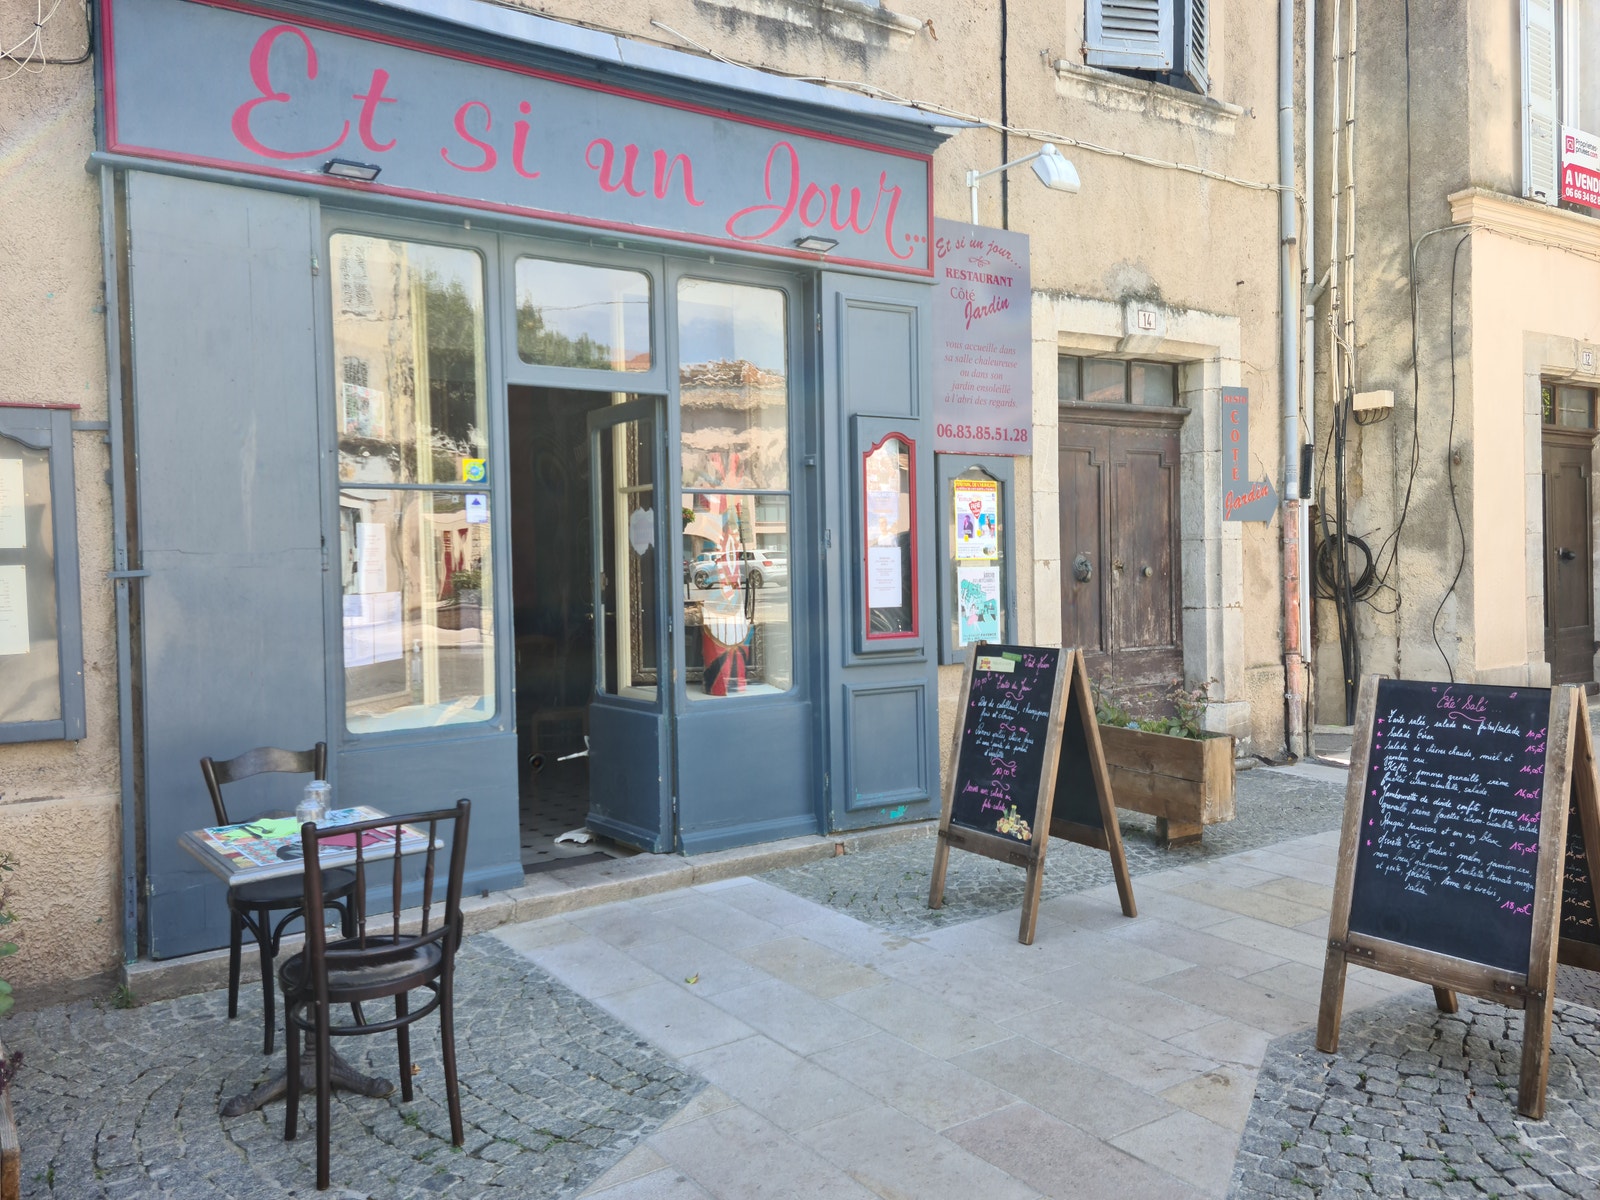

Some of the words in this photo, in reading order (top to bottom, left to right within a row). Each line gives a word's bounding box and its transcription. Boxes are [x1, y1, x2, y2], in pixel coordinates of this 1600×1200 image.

[231, 24, 398, 160] Et
[440, 100, 541, 180] si
[585, 138, 706, 207] un
[1565, 169, 1573, 186] A
[1574, 171, 1600, 195] VEND
[1565, 187, 1573, 197] 06
[1582, 191, 1590, 202] 34
[935, 237, 951, 258] Et
[955, 236, 966, 250] si
[969, 239, 984, 249] un
[945, 267, 1014, 288] RESTAURANT
[950, 286, 975, 302] Côté
[964, 295, 1010, 331] Jardin
[1143, 312, 1152, 327] 14
[945, 340, 963, 350] vous
[964, 342, 997, 353] accueille
[998, 344, 1016, 355] dans
[944, 354, 953, 362] sa
[955, 353, 973, 364] salle
[974, 355, 1018, 369] chaleureuse
[960, 369, 970, 377] ou
[971, 368, 988, 379] dans
[990, 372, 1003, 381] son
[951, 380, 975, 392] jardin
[976, 383, 1012, 395] ensoleillé
[944, 393, 950, 403] à
[951, 393, 973, 405] l'abri
[974, 395, 987, 406] des
[936, 423, 1028, 443] 06.83.85.51.28
[1225, 484, 1269, 521] Jardin
